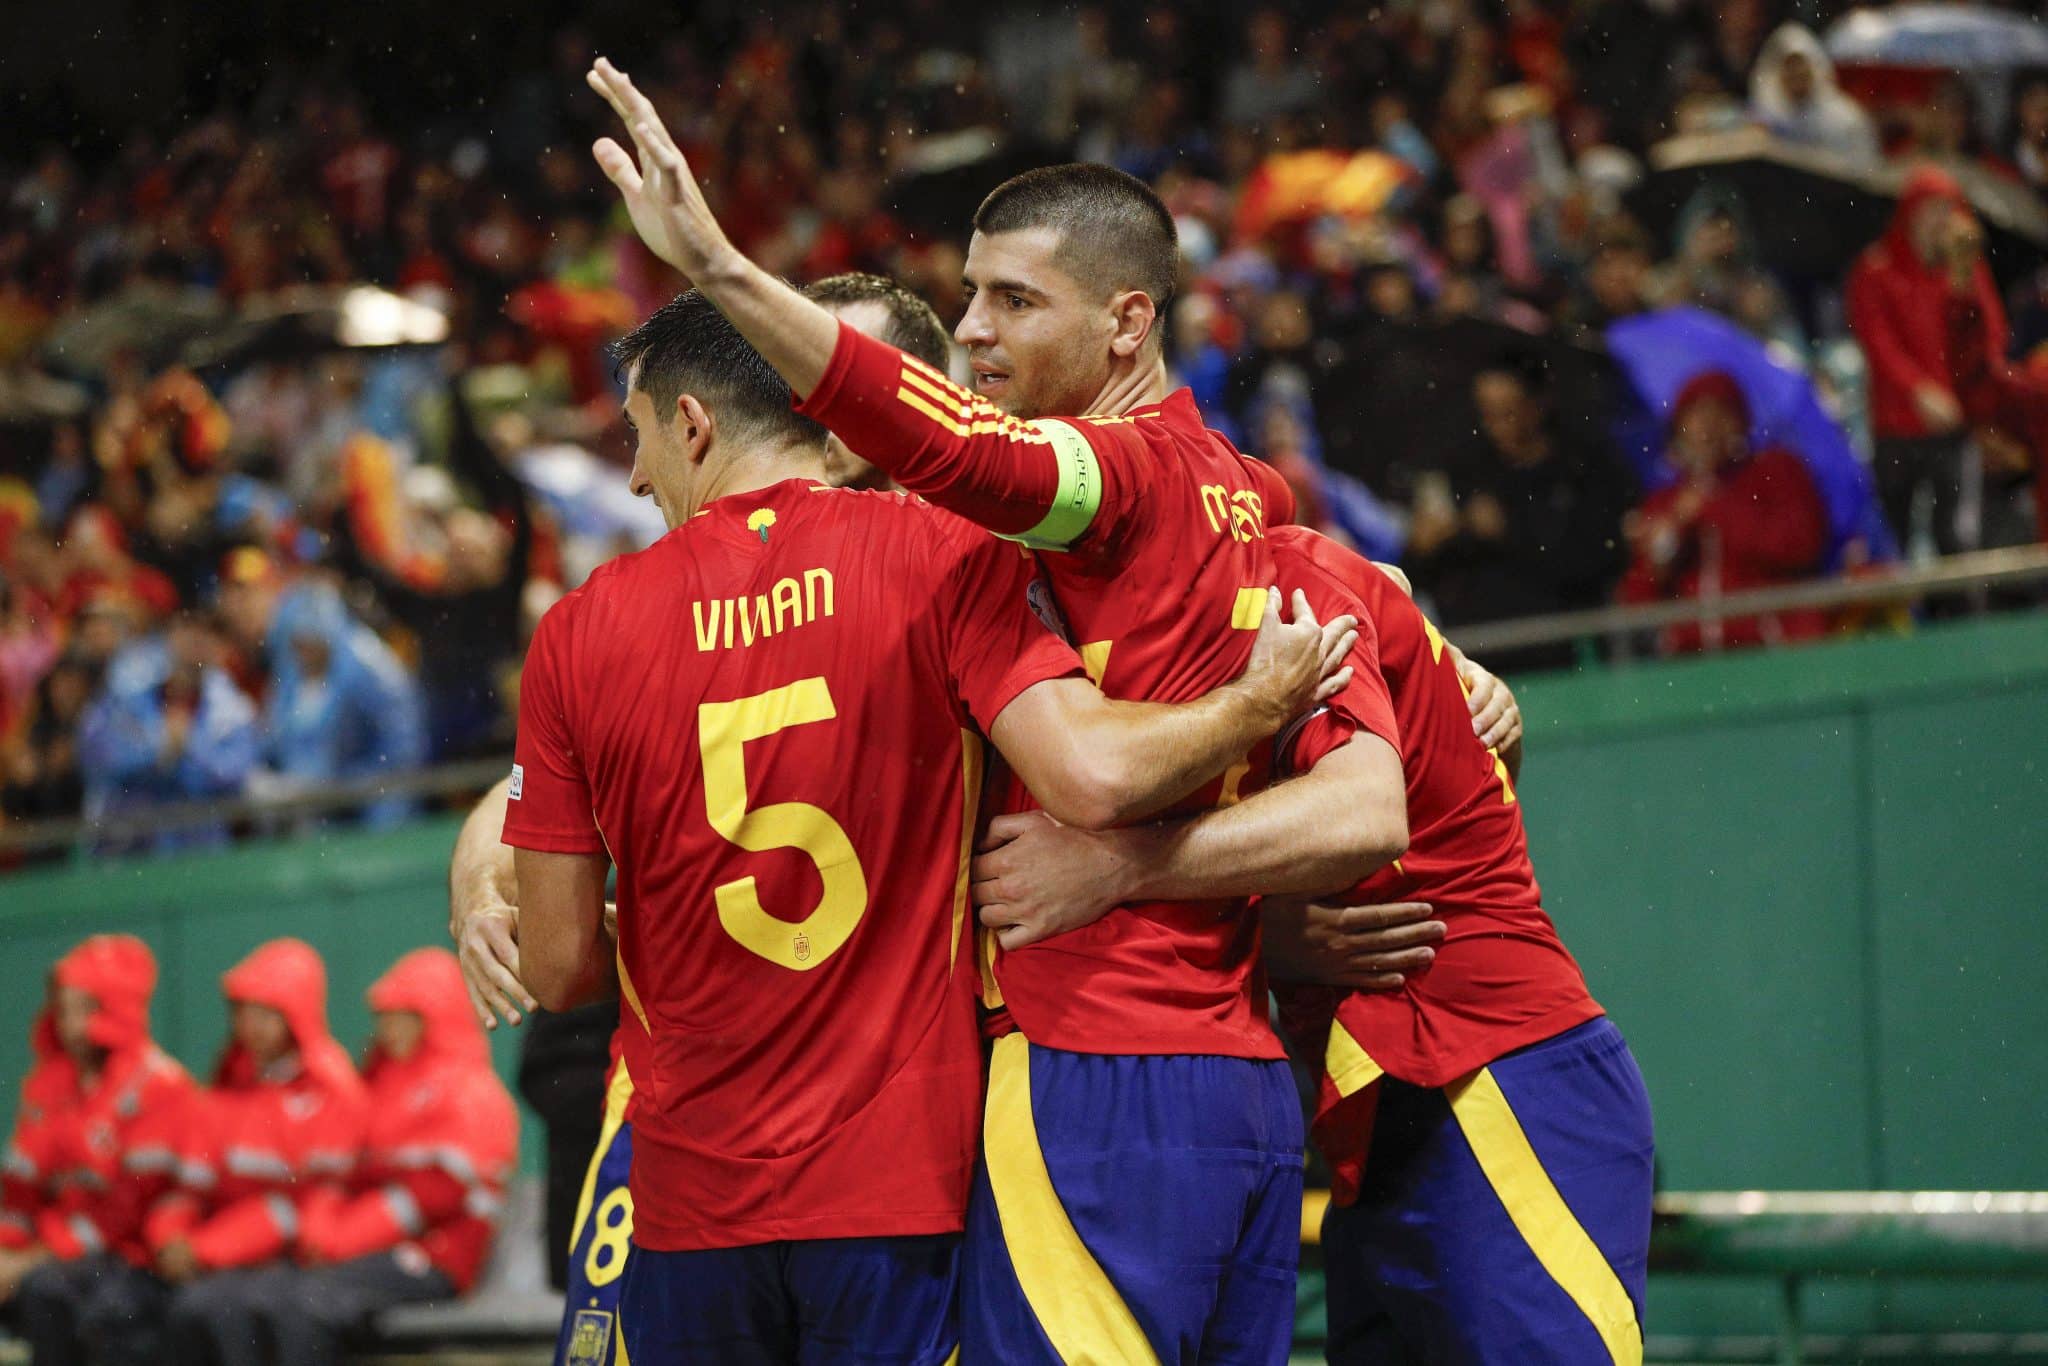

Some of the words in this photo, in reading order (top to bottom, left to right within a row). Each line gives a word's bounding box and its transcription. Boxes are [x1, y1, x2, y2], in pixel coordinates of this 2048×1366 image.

[1064, 430, 1087, 509] SPECT
[698, 676, 868, 971] 5
[585, 1186, 634, 1287] 8
